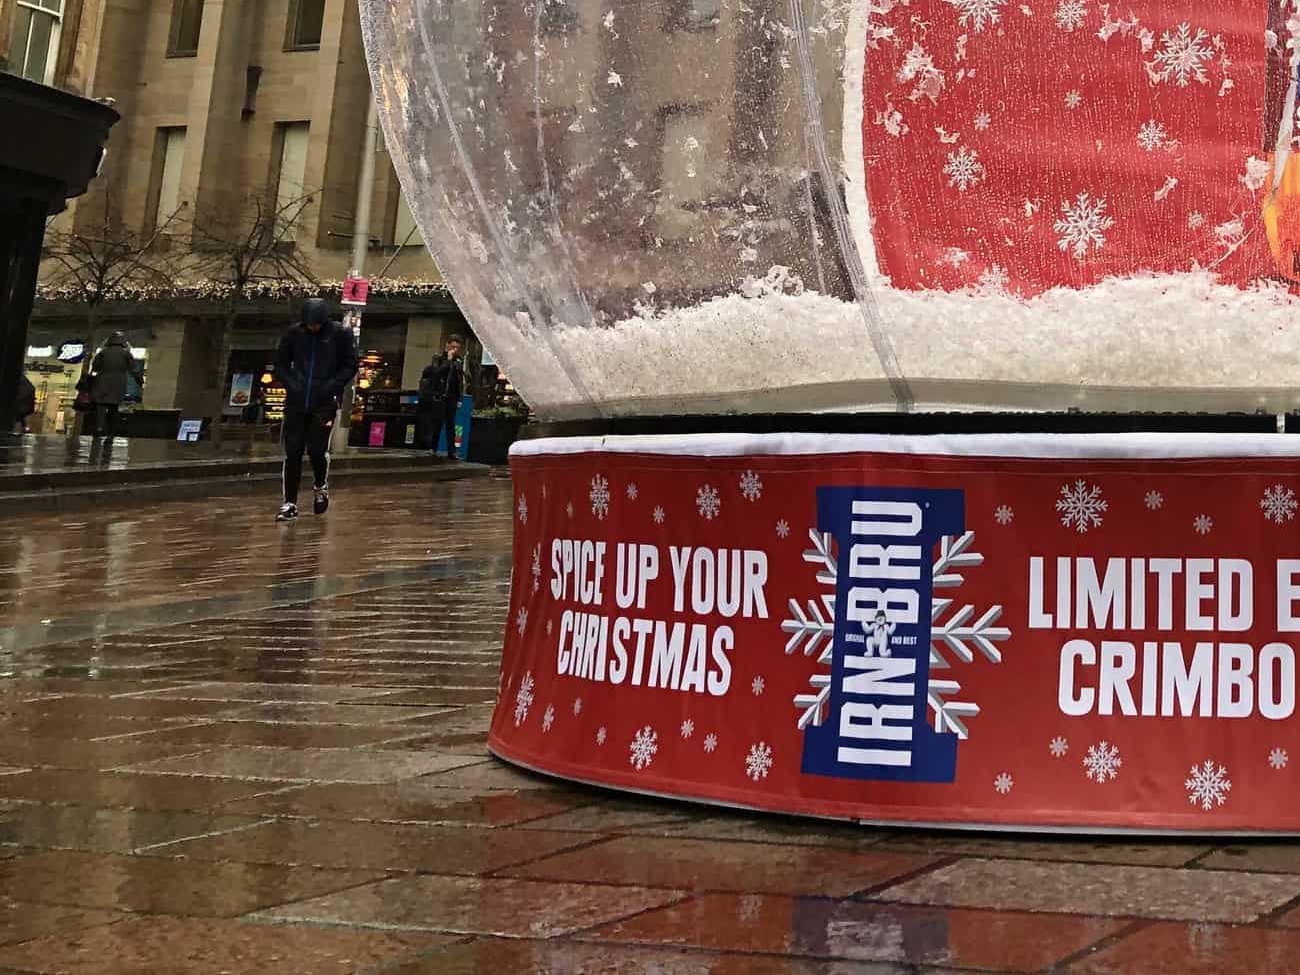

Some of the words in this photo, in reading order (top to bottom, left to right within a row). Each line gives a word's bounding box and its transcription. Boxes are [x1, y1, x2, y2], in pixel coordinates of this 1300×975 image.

[550, 538, 606, 606] SPICE
[615, 543, 659, 609] UP
[669, 546, 769, 620] YOUR
[1028, 556, 1254, 632] LIMITED
[556, 609, 734, 696] CHRISTMAS
[1057, 639, 1296, 721] CRIMBO
